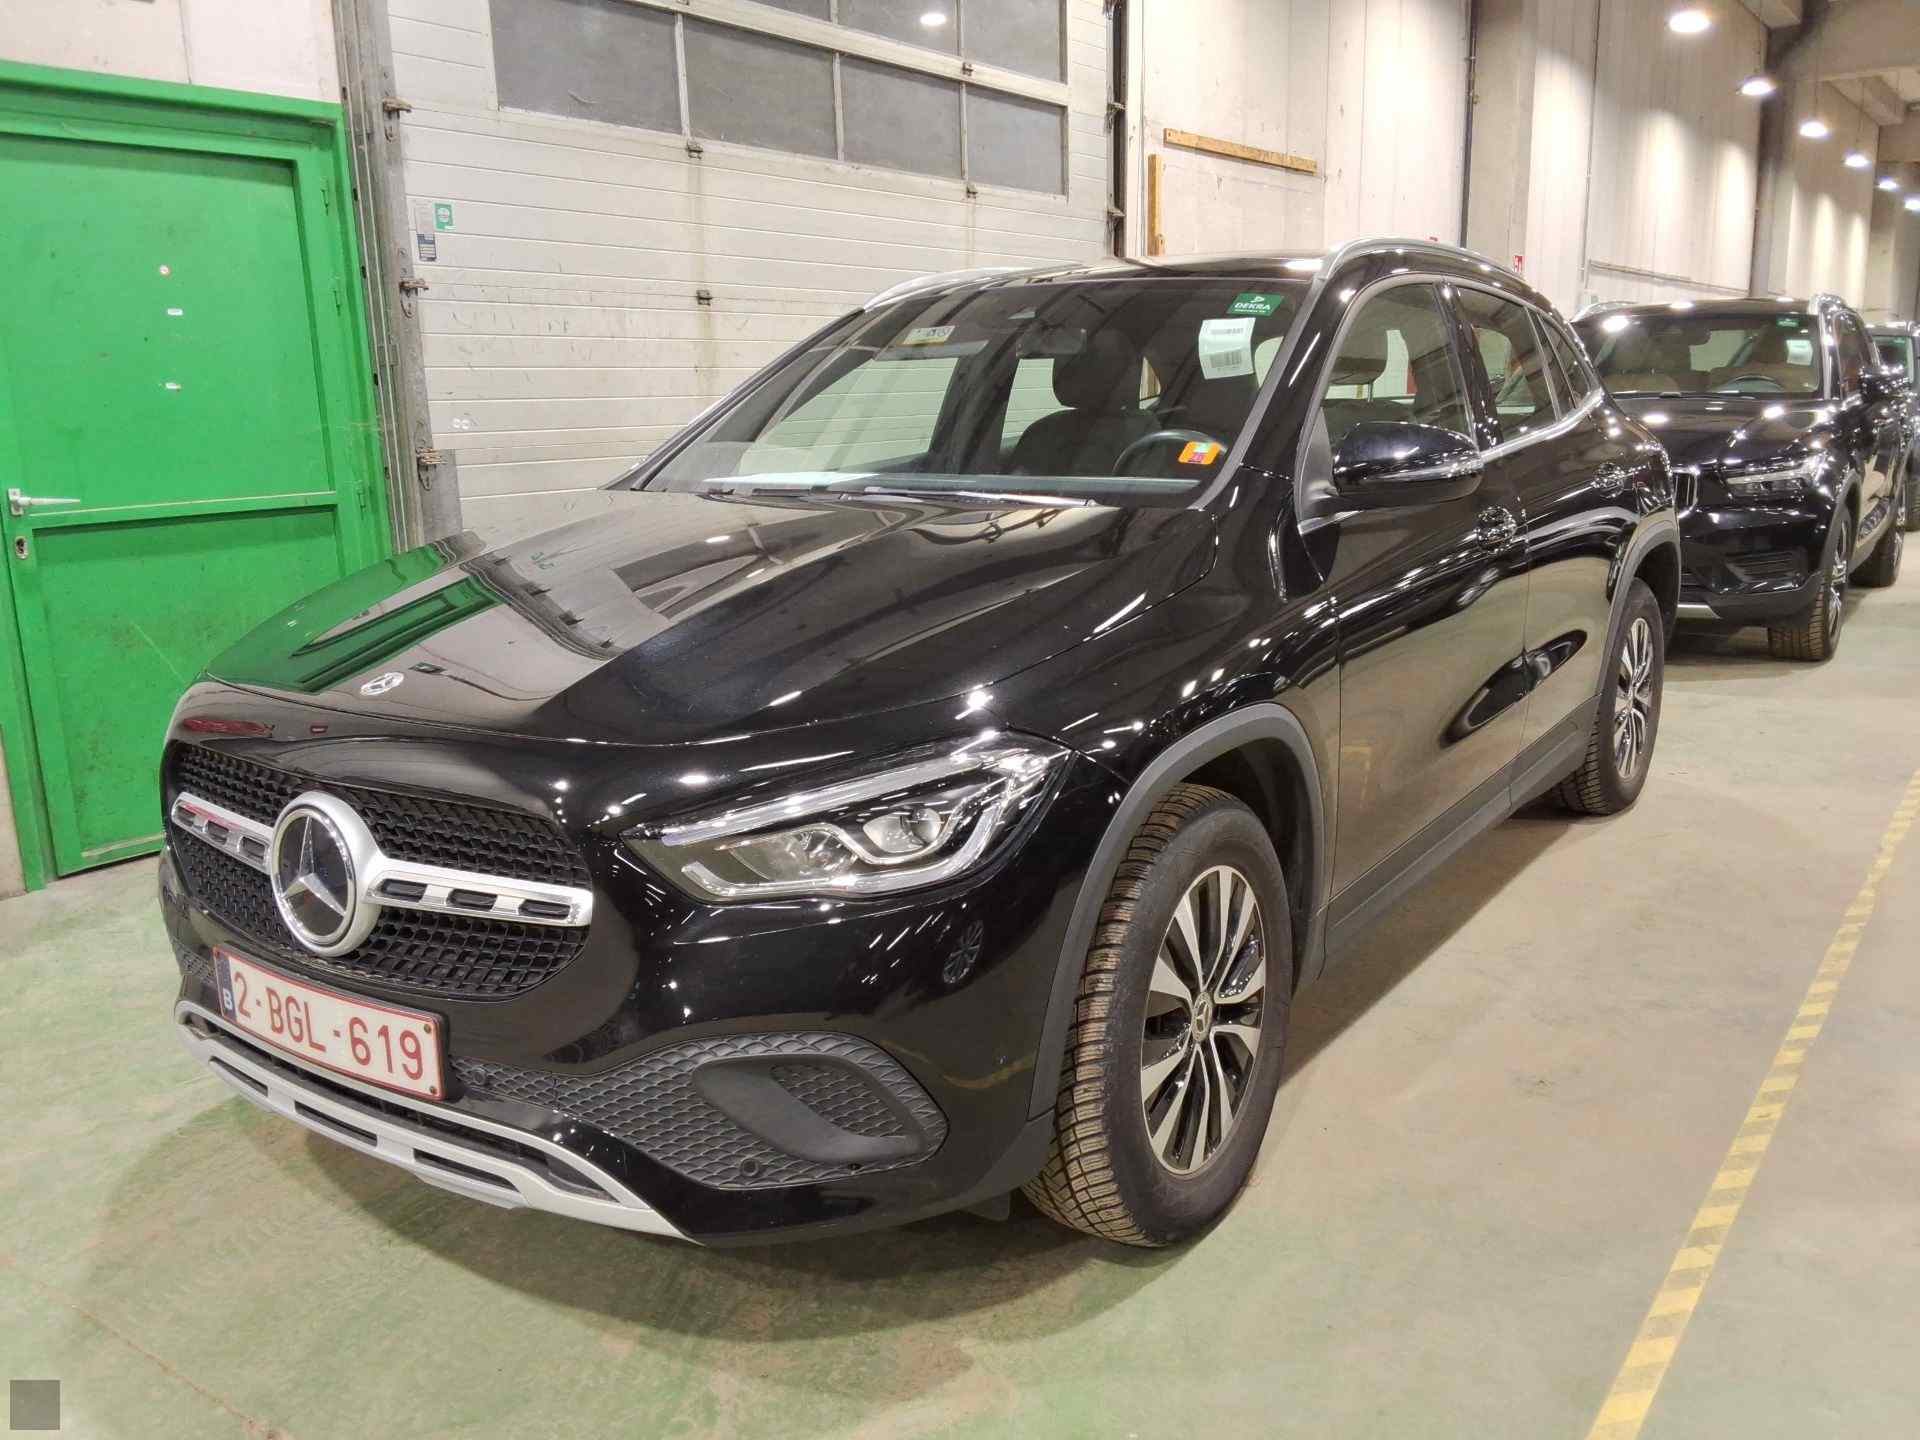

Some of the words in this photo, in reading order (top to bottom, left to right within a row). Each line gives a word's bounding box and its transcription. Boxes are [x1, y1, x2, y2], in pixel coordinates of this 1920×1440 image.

[1234, 302, 1271, 310] DEKRA
[223, 987, 233, 1010] B
[234, 971, 424, 1081] 2-BGL-619
